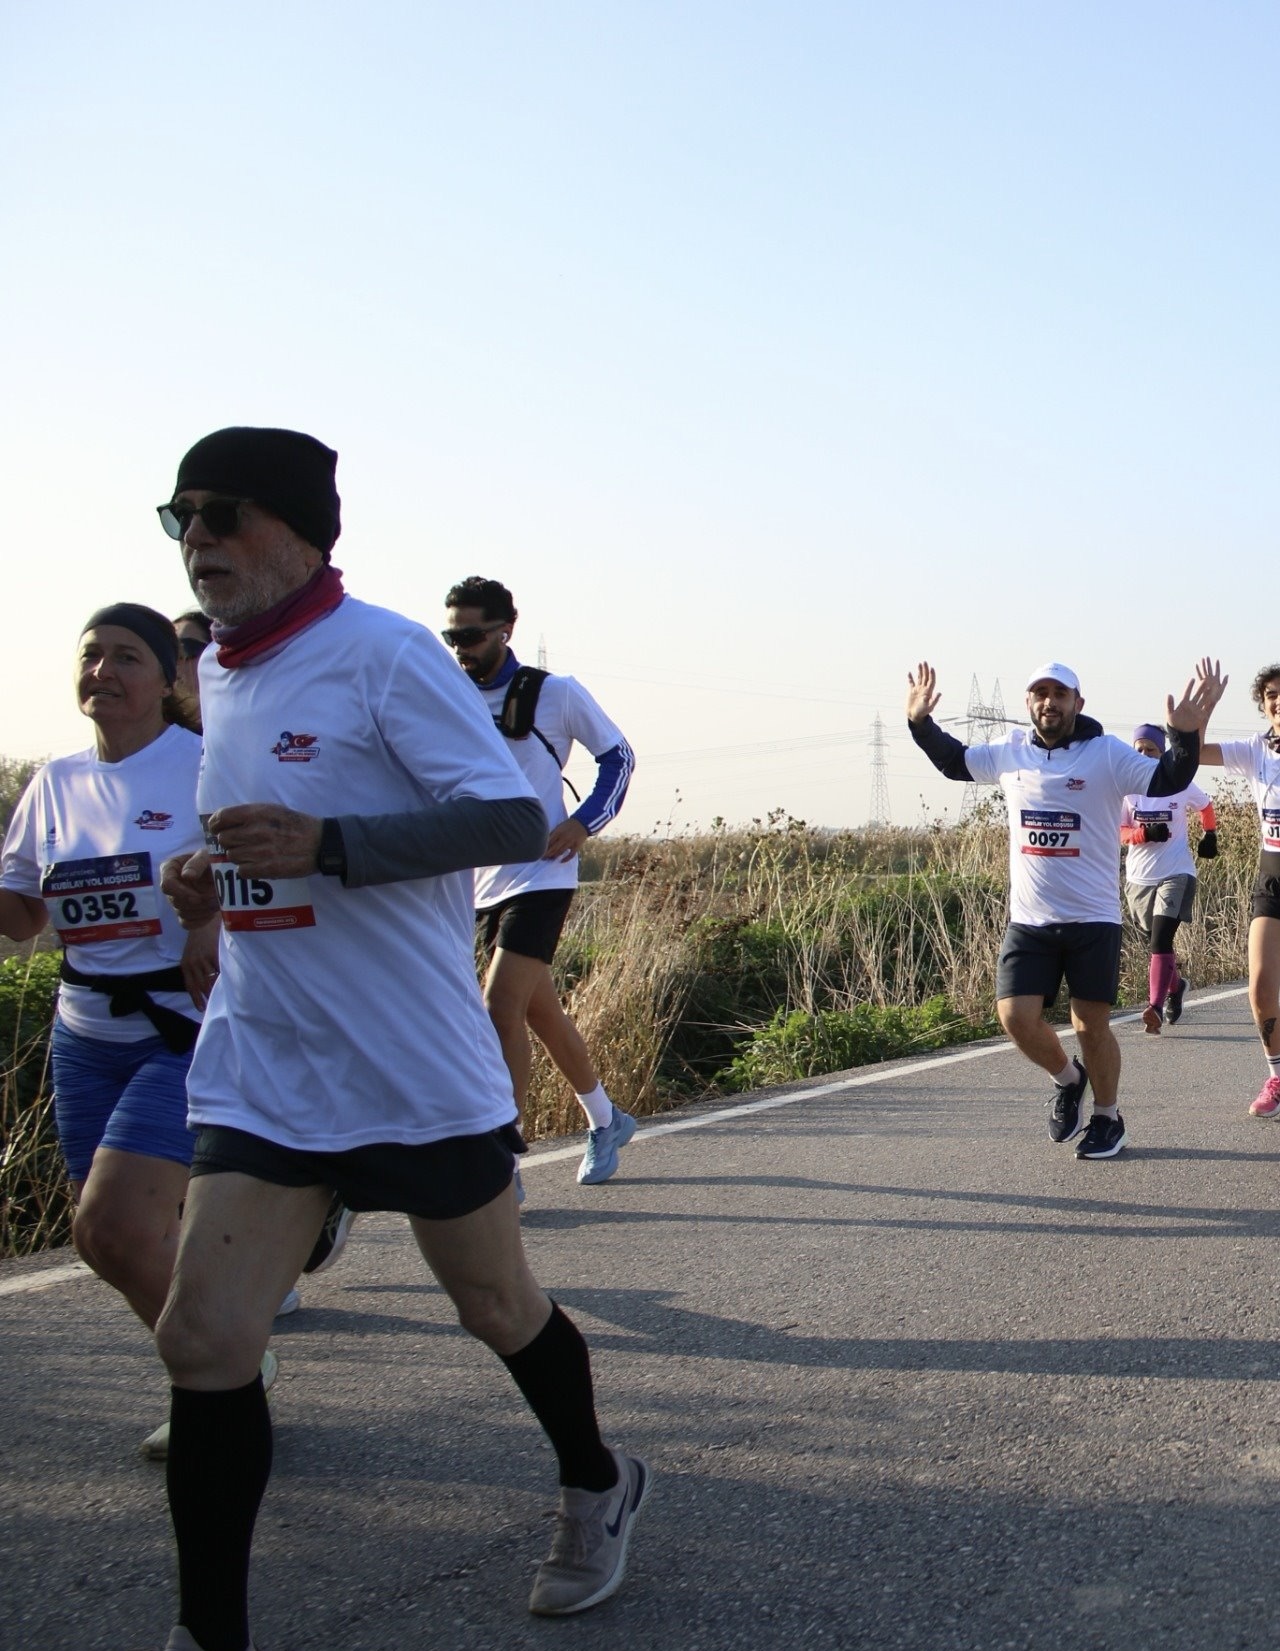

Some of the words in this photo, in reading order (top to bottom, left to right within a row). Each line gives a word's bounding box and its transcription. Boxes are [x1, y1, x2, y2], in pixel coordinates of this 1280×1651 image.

[1029, 831, 1070, 847] 0097
[51, 879, 84, 891] KUBİLAY
[85, 878, 103, 887] YOL
[104, 873, 141, 885] KOŞUSU
[214, 869, 274, 906] 0115
[62, 891, 139, 924] 0352
